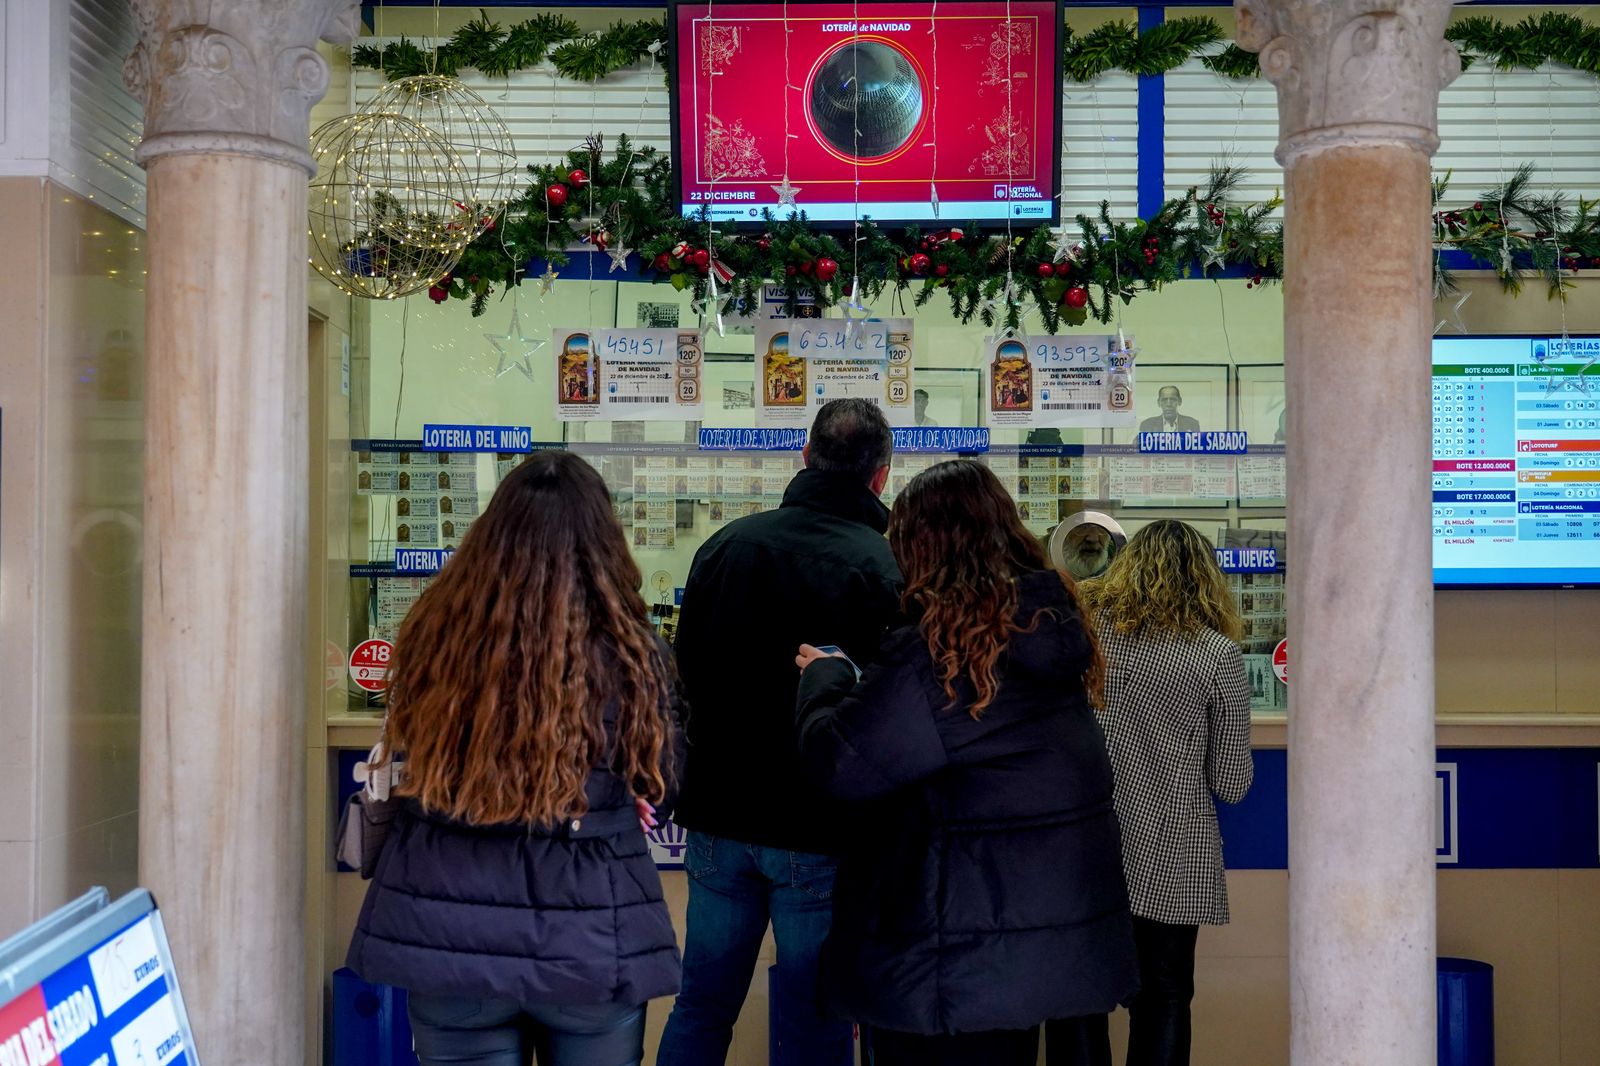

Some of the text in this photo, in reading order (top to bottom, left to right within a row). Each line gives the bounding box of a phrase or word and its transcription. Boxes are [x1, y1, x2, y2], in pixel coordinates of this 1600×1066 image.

[822, 22, 911, 32] LOTERÍA de NAVIDAD
[690, 192, 756, 200] 22 DICIEMBRE
[1009, 185, 1036, 193] LOTERÍA
[607, 335, 664, 355] 45.451
[800, 330, 887, 350] 65.462
[1036, 344, 1101, 364] 93.593
[683, 386, 694, 395] 20
[893, 387, 904, 396] 20
[1114, 393, 1125, 401] 20
[424, 426, 529, 449] LOTERIA DEL NIÑO
[699, 427, 808, 451] LOTERIA DE NAVIDAD
[924, 429, 941, 449] DE
[940, 427, 990, 451] NAVIDAD
[1140, 432, 1246, 451] LOTERIA DEL SABADO
[397, 551, 439, 570] LOTERIA
[1217, 550, 1276, 568] DEL JUEVES
[361, 645, 391, 662] +18
